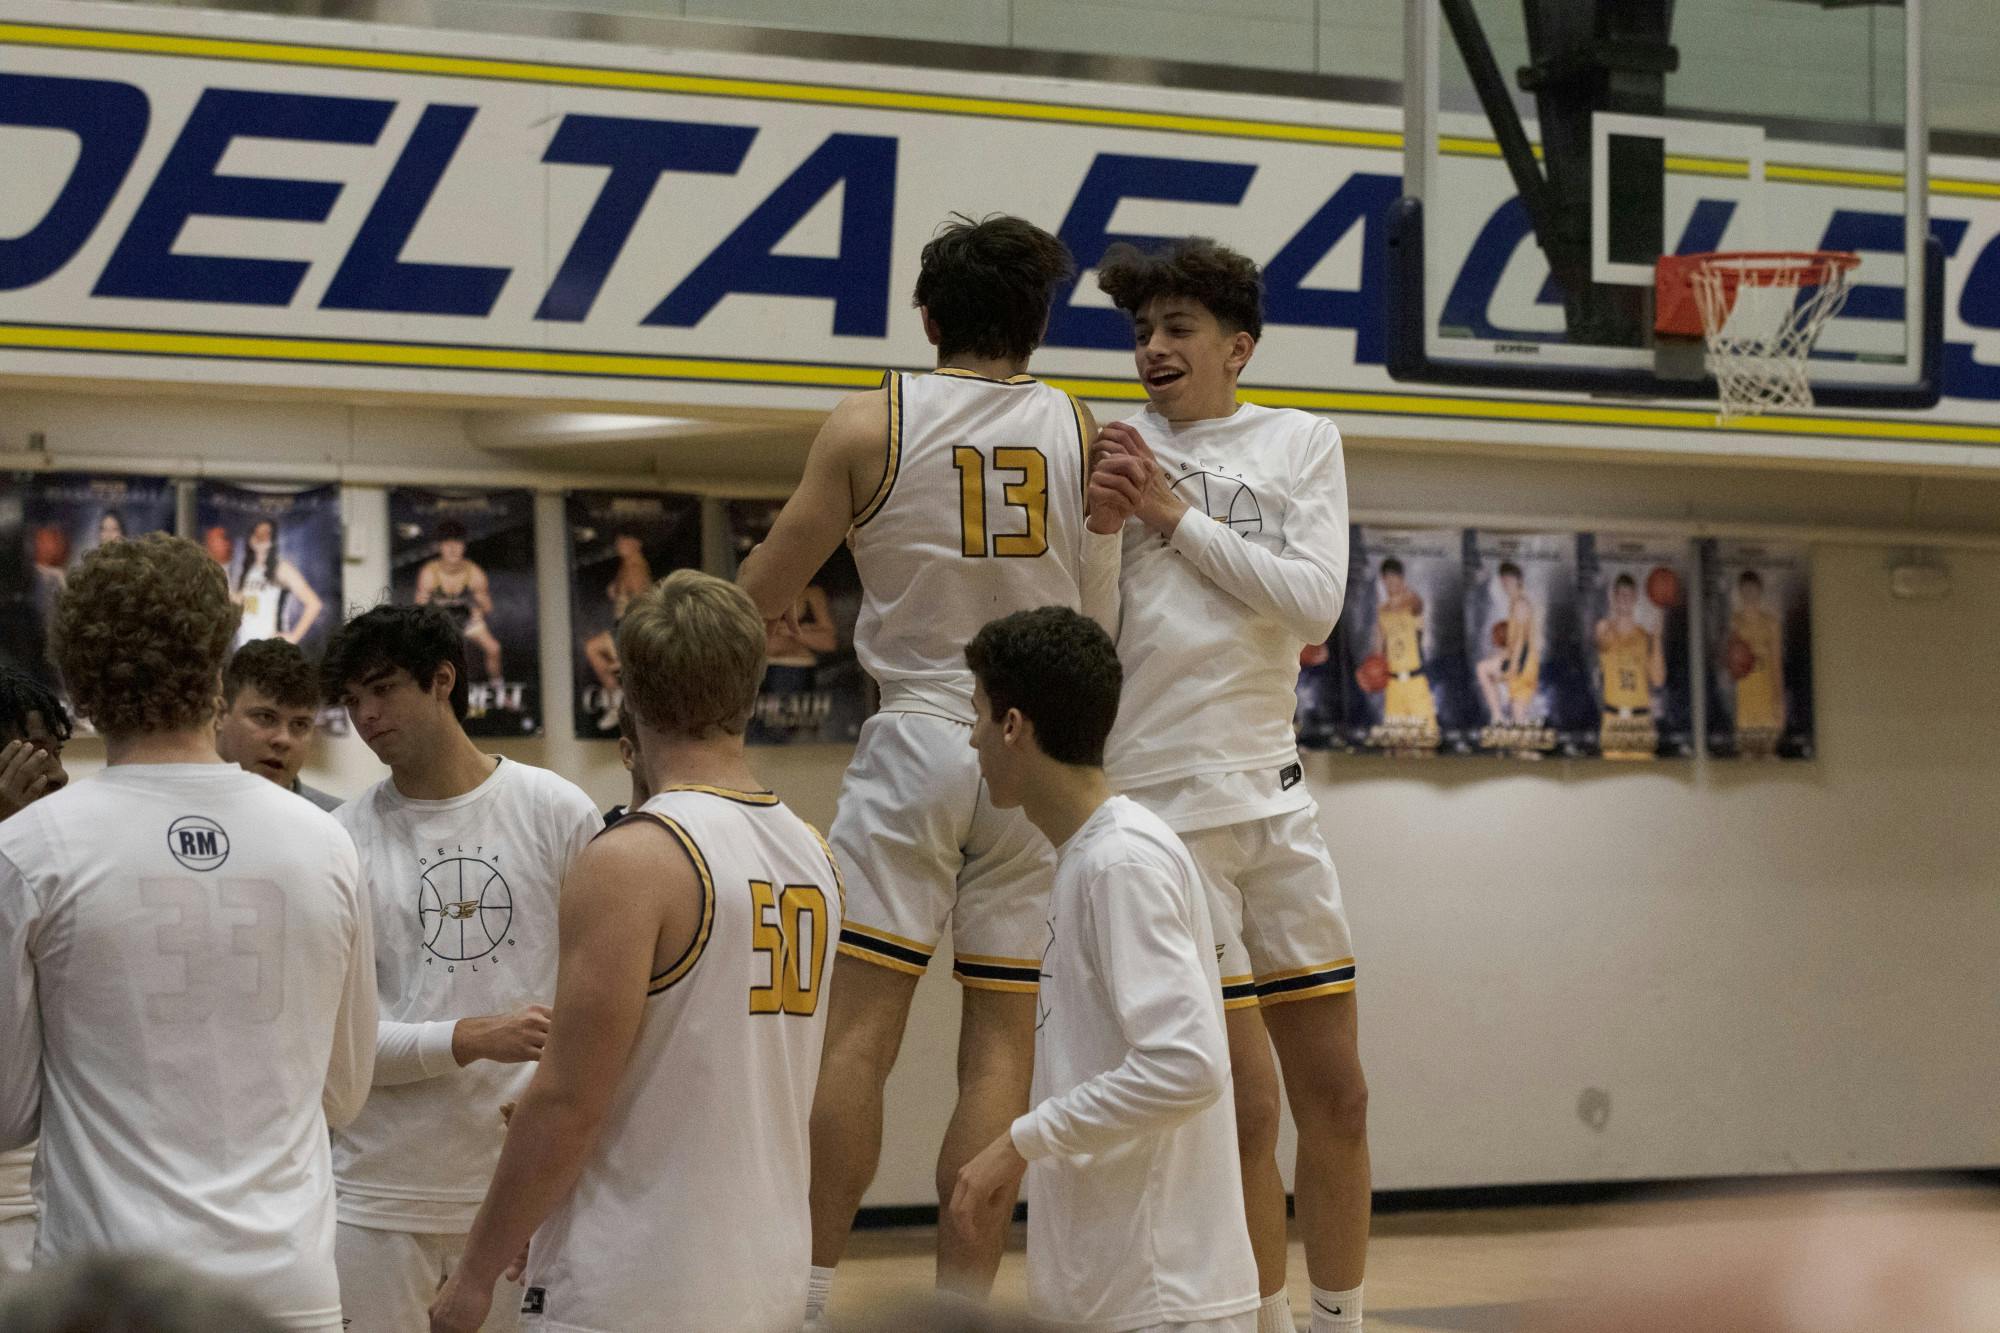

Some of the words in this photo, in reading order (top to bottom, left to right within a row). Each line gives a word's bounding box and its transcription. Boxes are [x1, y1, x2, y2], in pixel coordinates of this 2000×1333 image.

[952, 445, 1049, 557] 13
[179, 831, 218, 855] RM
[419, 844, 499, 867] DELTA
[748, 879, 828, 1017] 50
